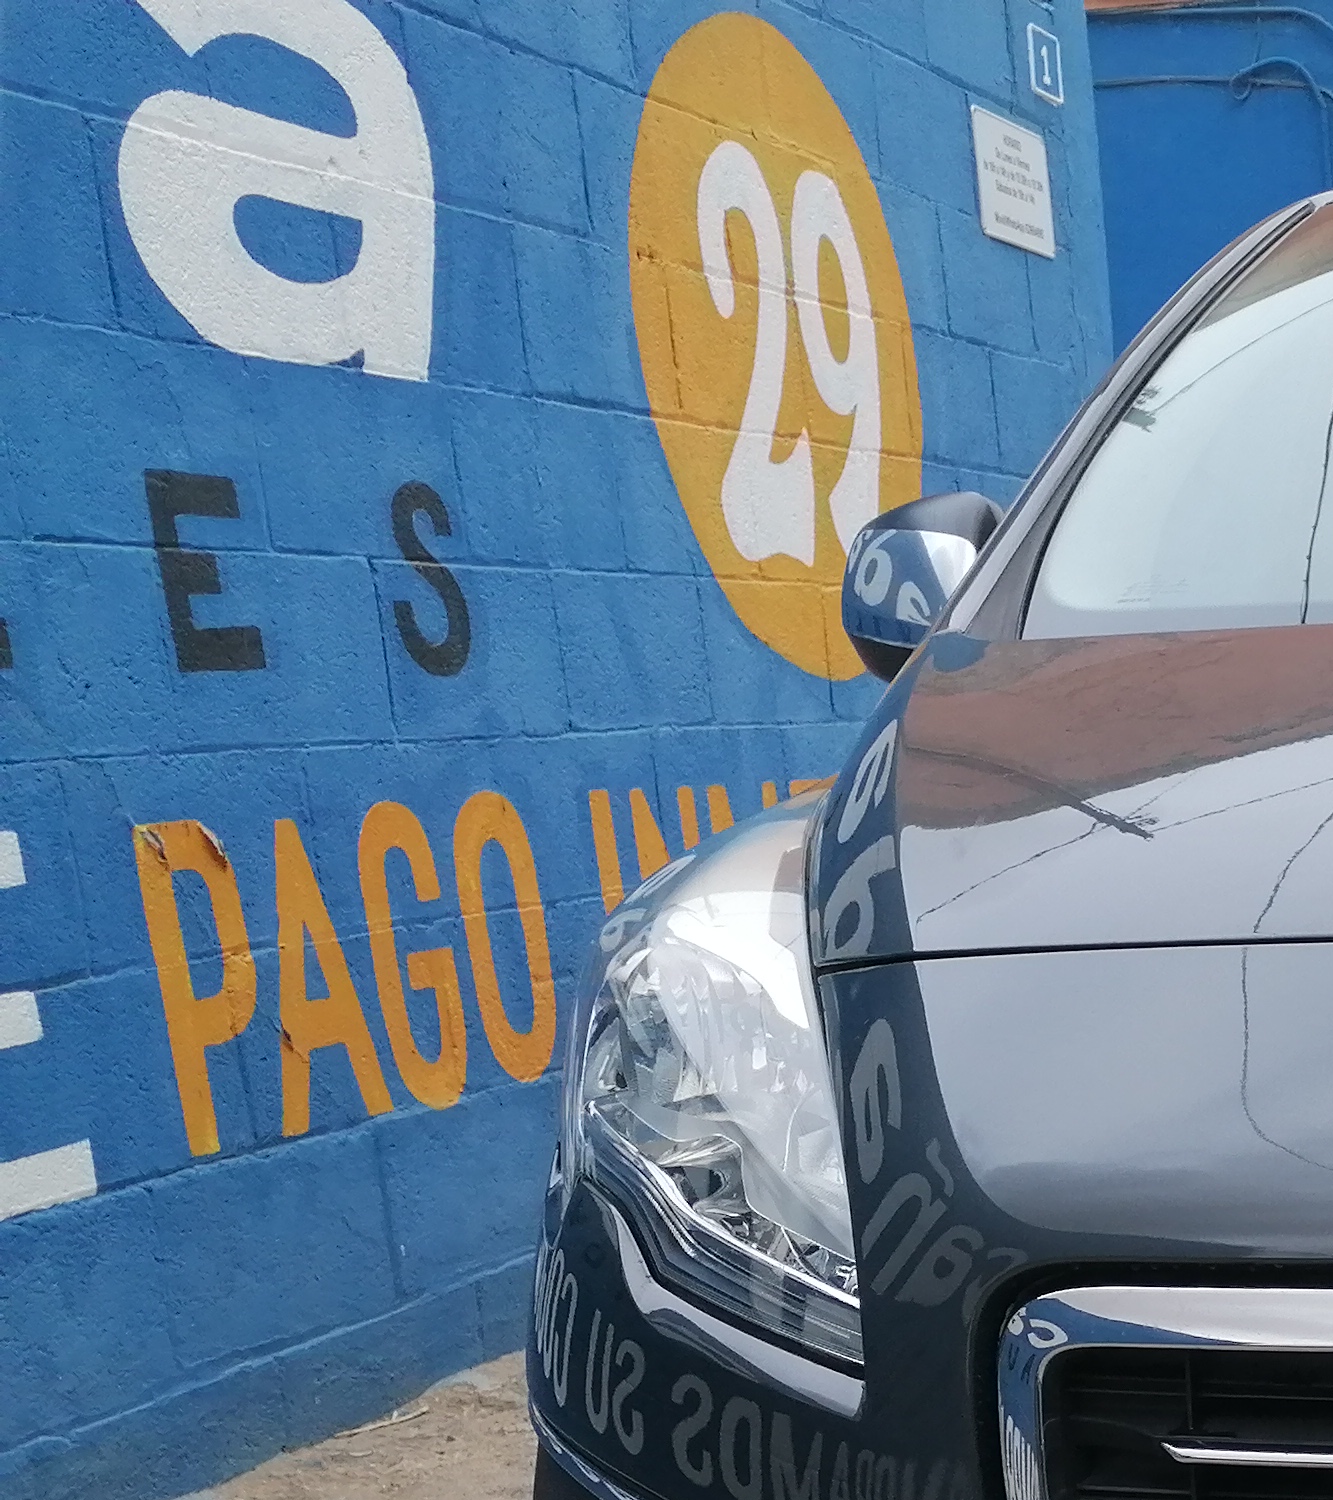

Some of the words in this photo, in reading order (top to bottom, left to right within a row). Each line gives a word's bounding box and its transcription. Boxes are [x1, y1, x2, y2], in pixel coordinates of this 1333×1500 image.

[697, 139, 881, 569] 29
[0, 468, 472, 677] ES
[134, 791, 557, 1157] PAGO
